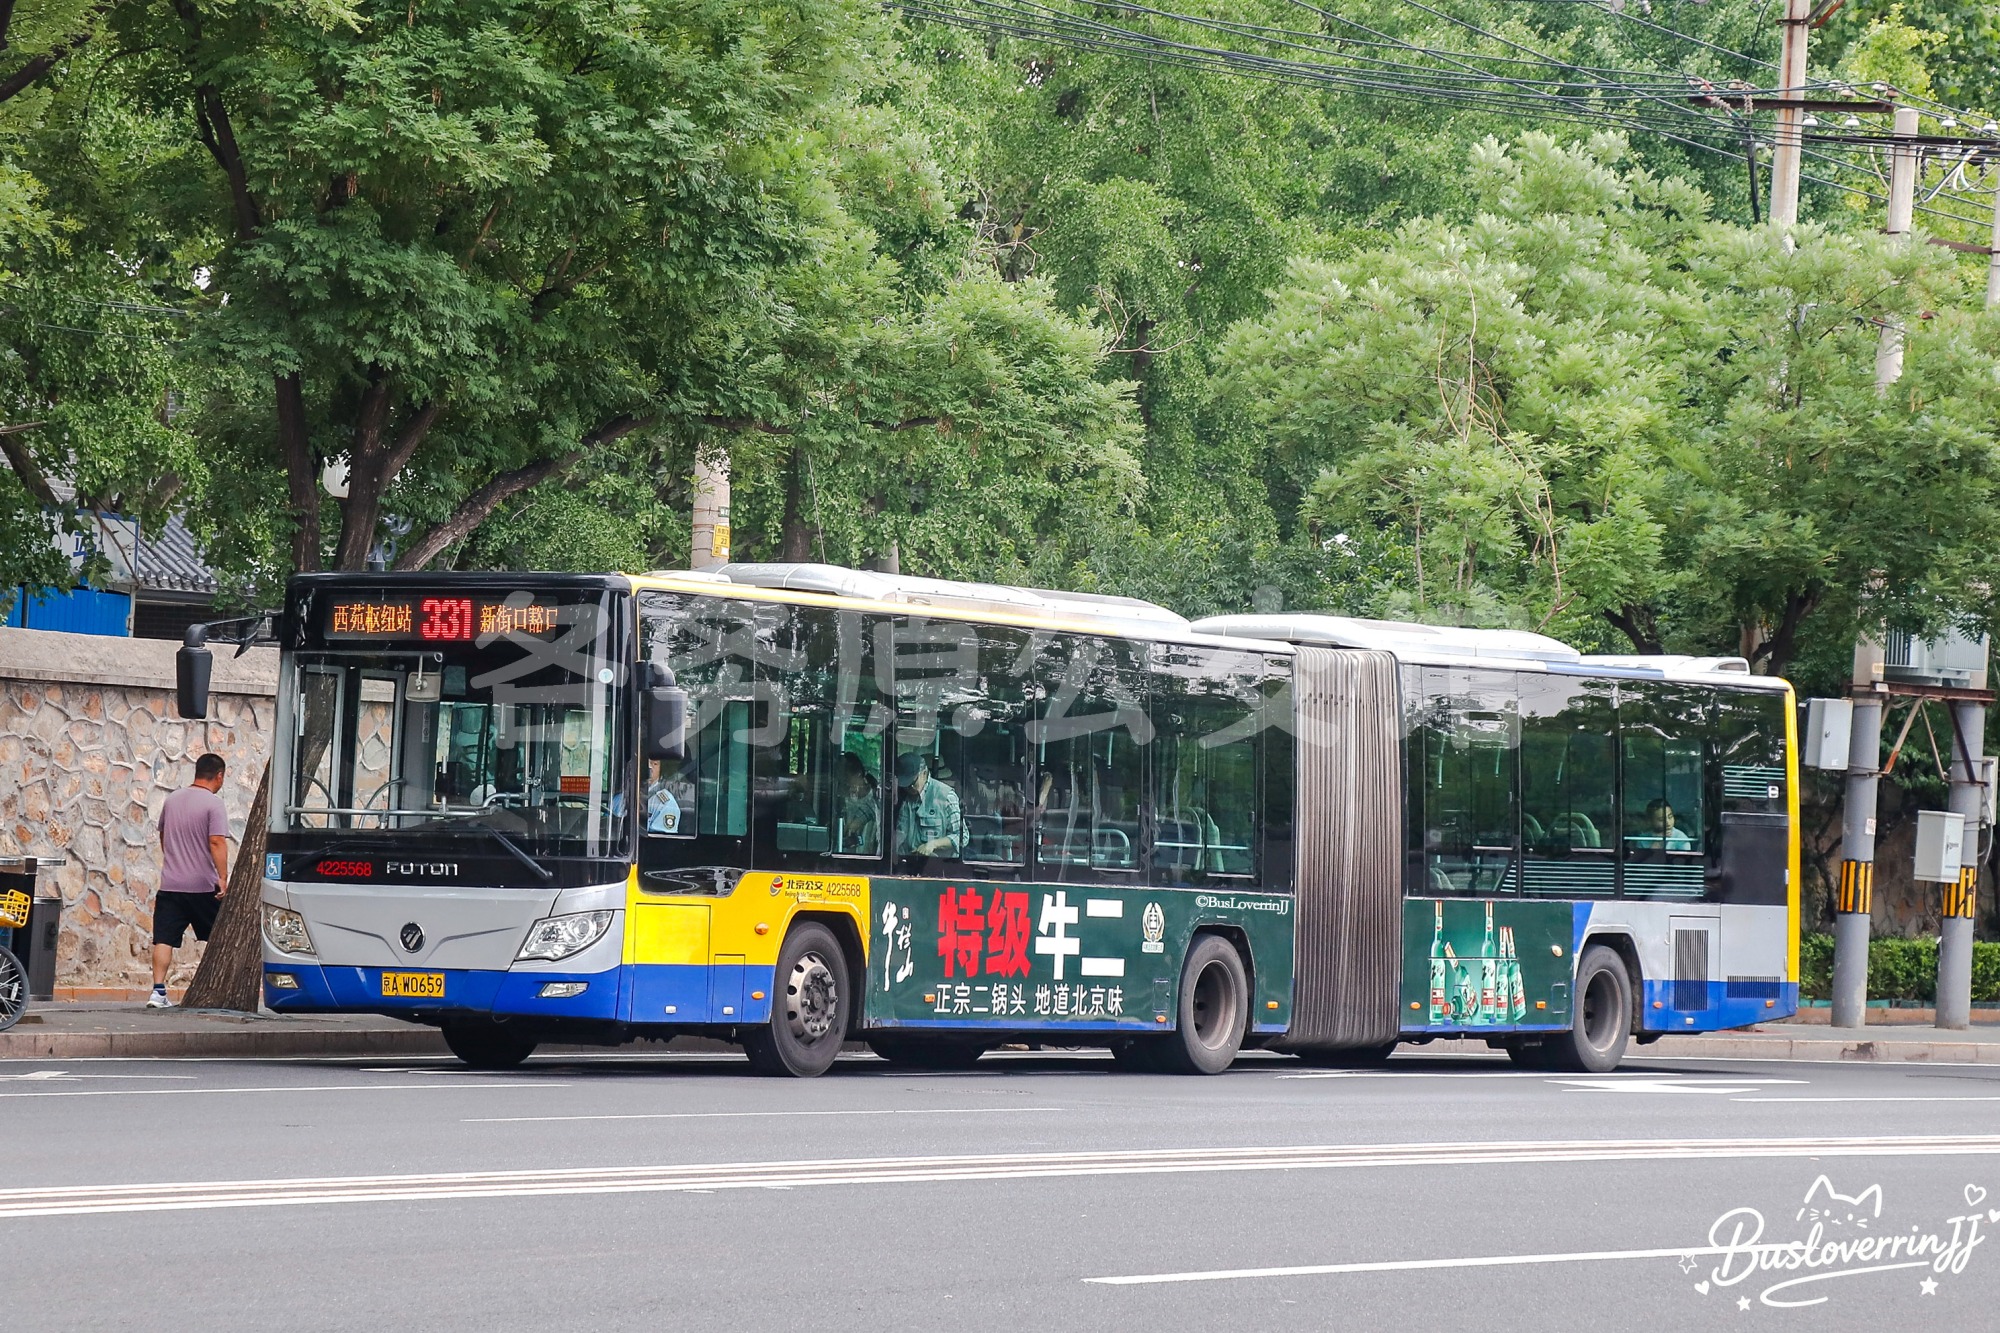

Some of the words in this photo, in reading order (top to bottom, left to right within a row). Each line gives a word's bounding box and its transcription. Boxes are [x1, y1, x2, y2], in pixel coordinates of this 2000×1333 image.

[333, 604, 412, 633] 西苑枢纽站
[422, 599, 472, 639] 331
[480, 604, 558, 634] 新街口豁口
[316, 861, 372, 877] 4225568
[786, 879, 823, 891] 北京公交
[826, 883, 861, 897] 4225568
[938, 887, 1126, 981] 特级牛二
[934, 983, 1027, 1015] 正宗二锅头
[1033, 984, 1125, 1017] 地道北京味
